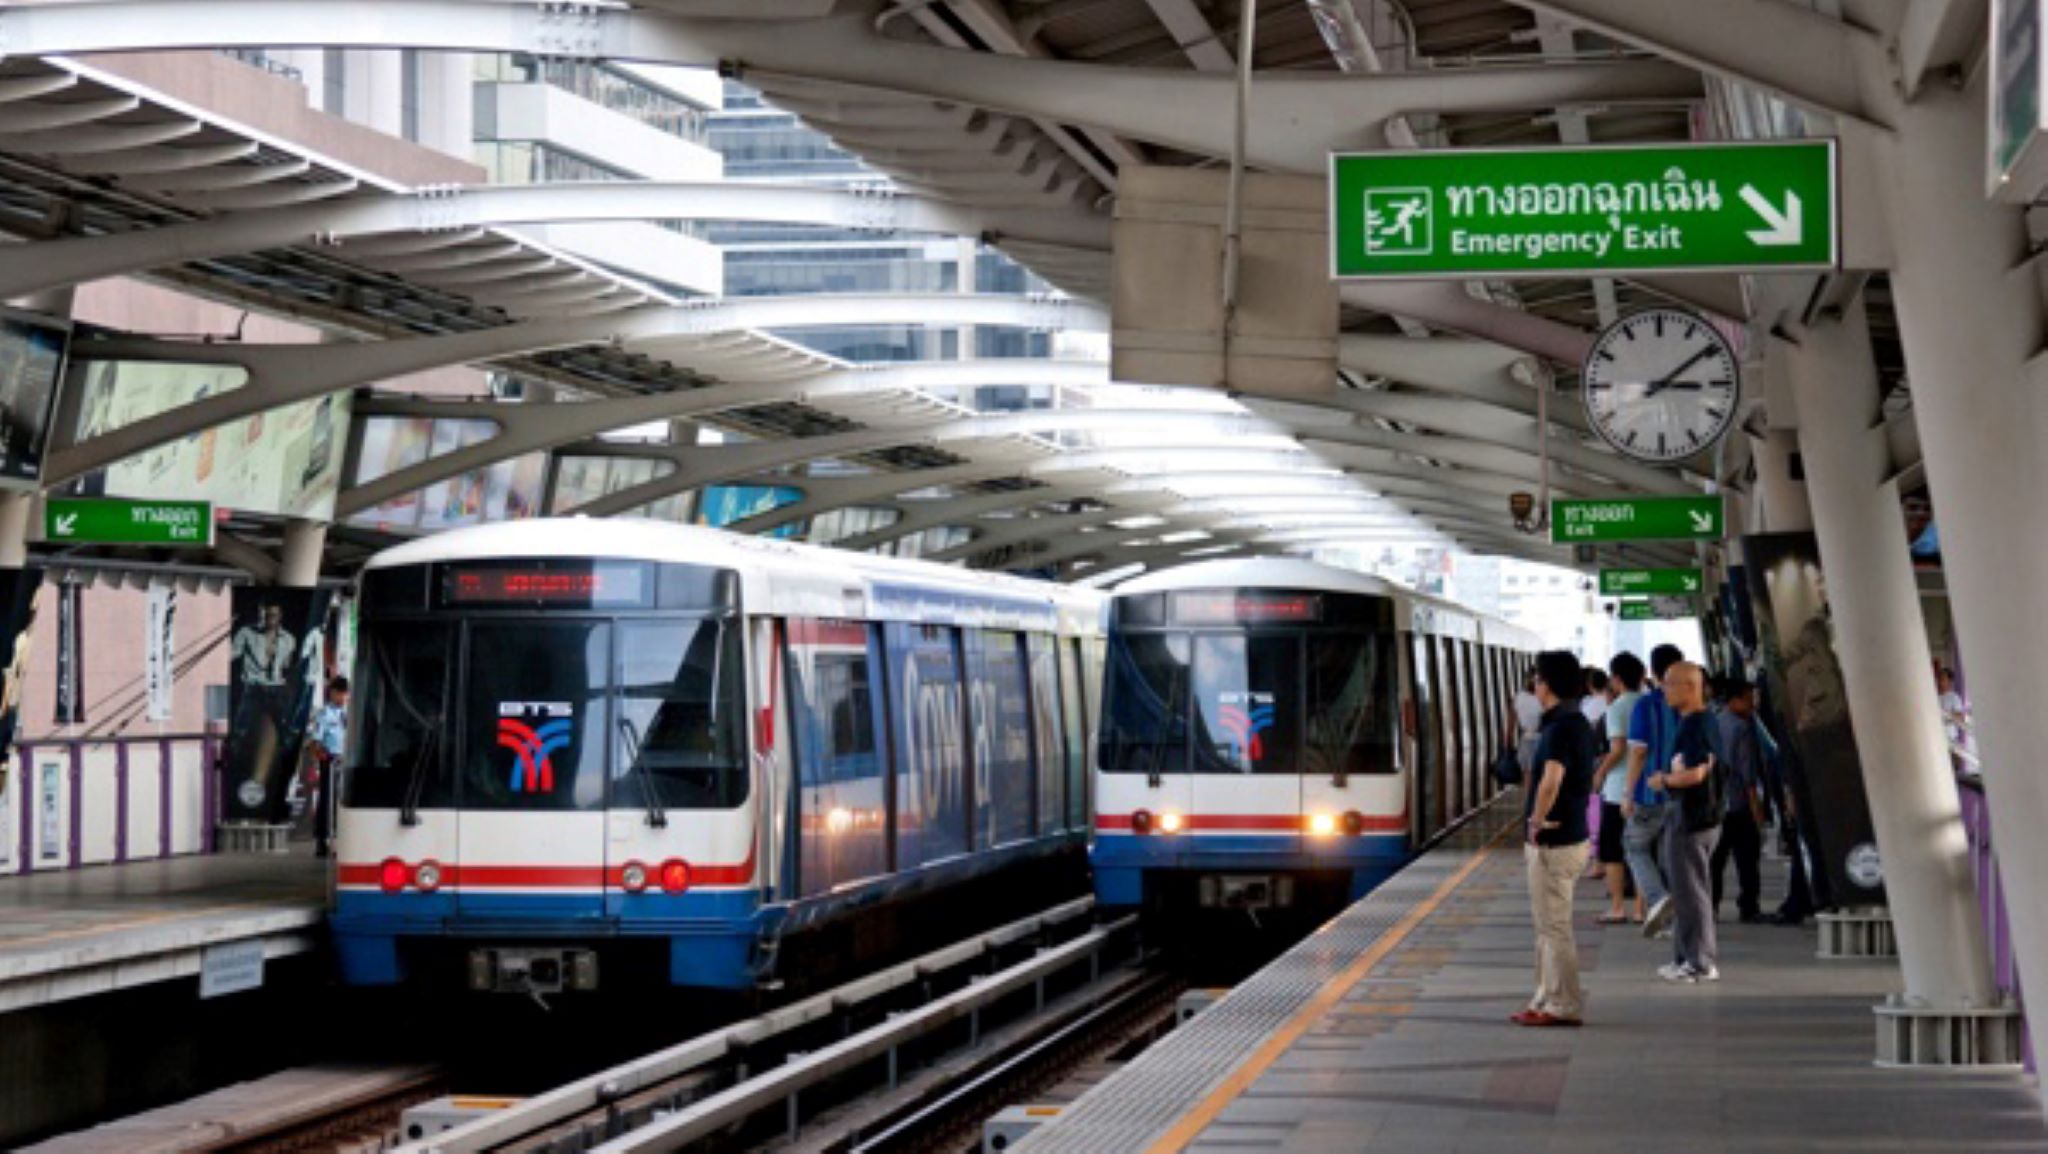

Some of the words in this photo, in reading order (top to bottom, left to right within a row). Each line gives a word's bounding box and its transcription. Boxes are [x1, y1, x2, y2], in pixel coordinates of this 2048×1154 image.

[1446, 166, 1723, 231] ทางออกฉุกเฉิน
[1451, 229, 1612, 259] Emergency
[1623, 223, 1683, 249] Exit
[1563, 504, 1635, 522] ทางออก
[499, 701, 573, 717] BTS
